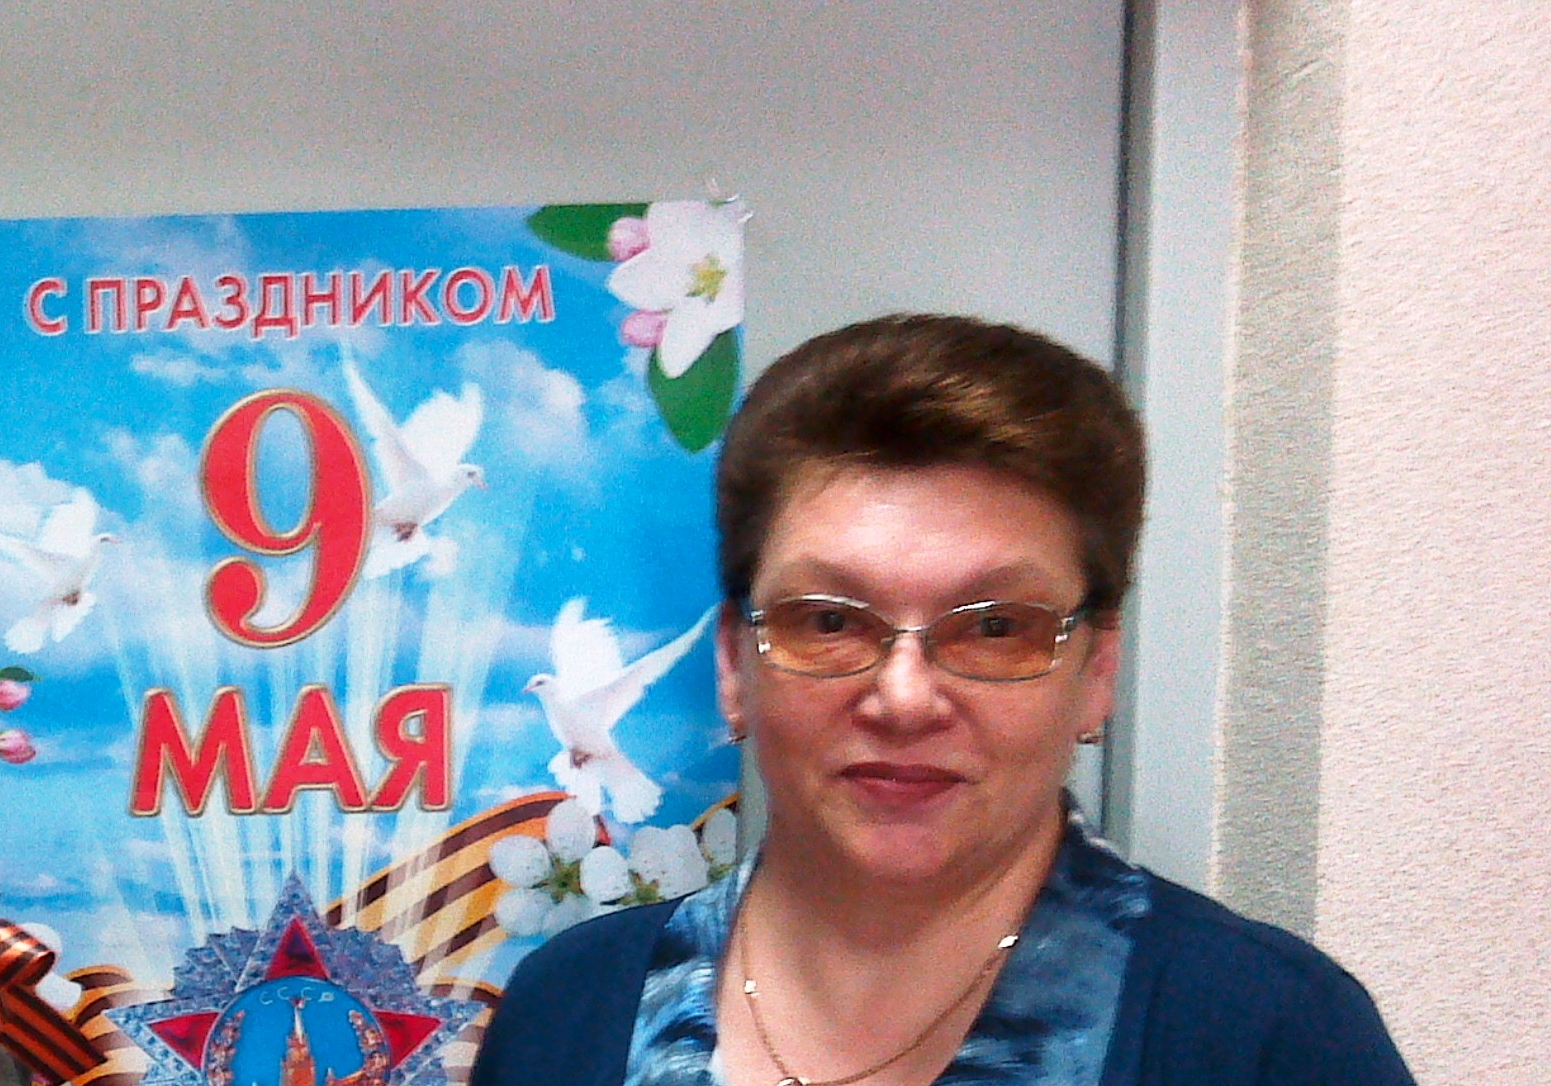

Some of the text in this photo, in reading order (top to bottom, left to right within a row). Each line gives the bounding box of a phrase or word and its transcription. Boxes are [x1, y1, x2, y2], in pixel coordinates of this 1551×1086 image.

[26, 265, 557, 340] С ПРАЗДНИКОМ
[201, 388, 371, 647] 9
[129, 683, 451, 816] МАЯ
